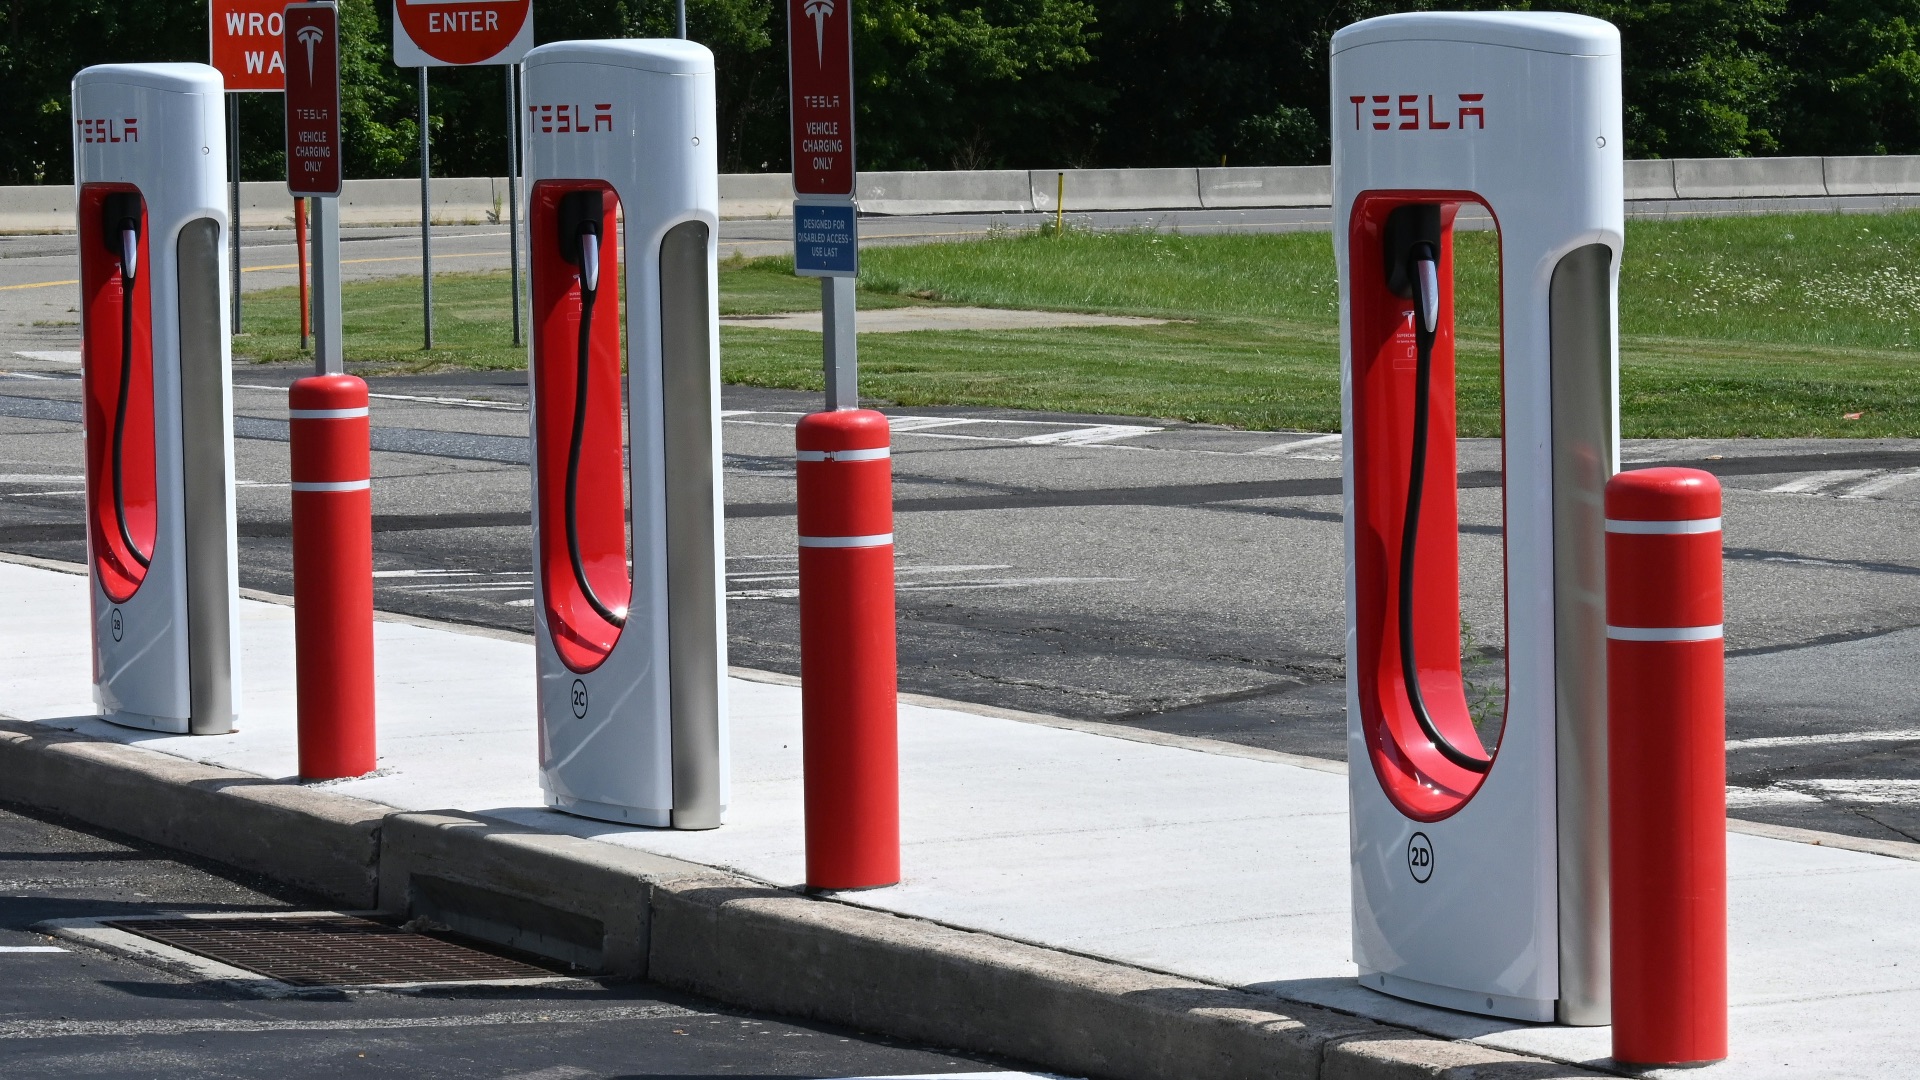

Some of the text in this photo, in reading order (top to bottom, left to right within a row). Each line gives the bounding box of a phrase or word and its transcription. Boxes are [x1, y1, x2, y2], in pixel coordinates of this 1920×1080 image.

[429, 10, 499, 33] ENTER
[244, 50, 285, 74] WA
[803, 95, 840, 108] TESLA
[296, 109, 328, 120] TESLA
[529, 103, 612, 133] TESLA
[1349, 93, 1485, 131] TESLA
[76, 118, 138, 144] TESLA
[806, 122, 839, 135] VEHICLE
[298, 131, 327, 143] VEHICLE
[295, 146, 331, 158] CHARGING
[802, 139, 843, 153] CHARGING
[304, 160, 322, 172] ONLY
[812, 157, 833, 170] ONLY
[803, 218, 845, 230] DESIGNED FOR
[797, 232, 826, 243] DISABLED
[826, 233, 848, 244] ACCESS
[811, 246, 838, 258] USE LAST
[573, 690, 585, 707] 2C
[1411, 846, 1430, 867] 2D
